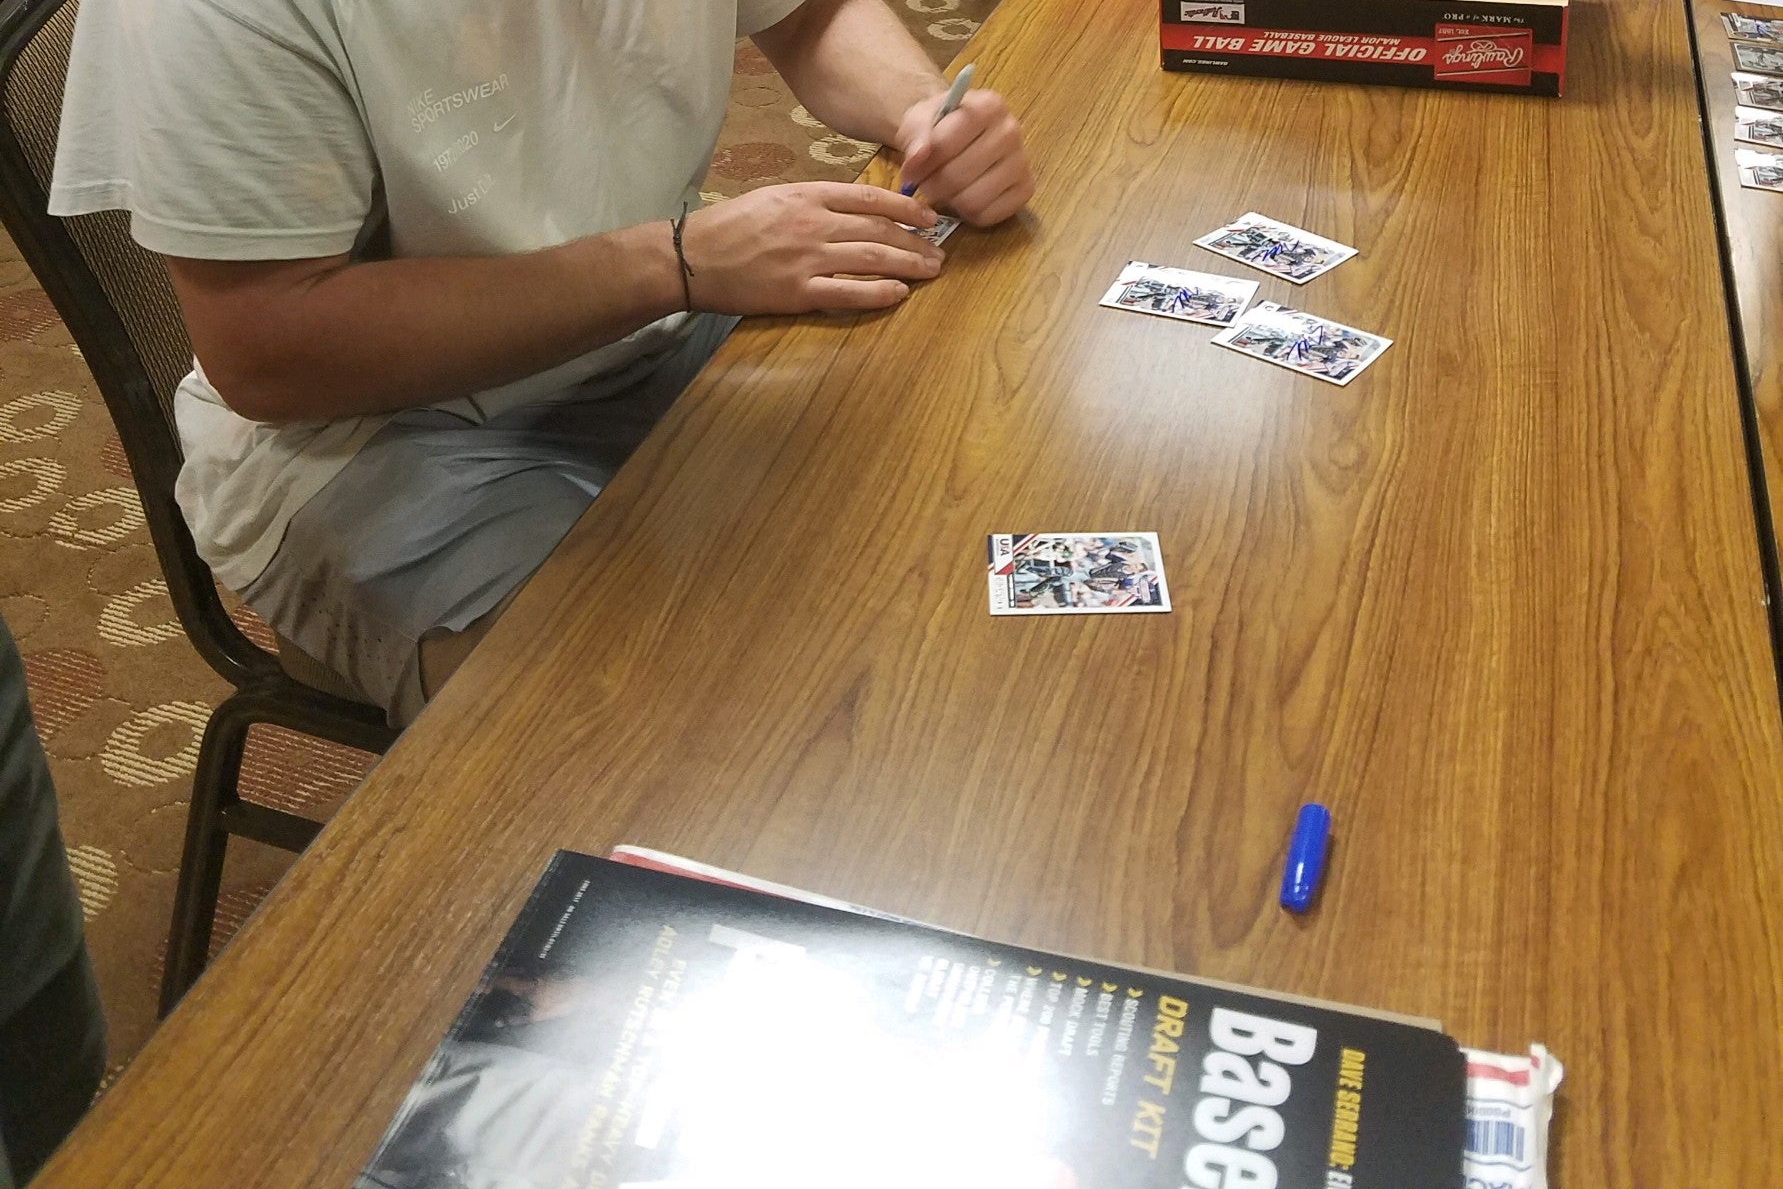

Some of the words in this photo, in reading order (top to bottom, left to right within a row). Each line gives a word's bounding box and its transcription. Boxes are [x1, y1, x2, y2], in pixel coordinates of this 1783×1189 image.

[1443, 12, 1466, 20] PRO
[1482, 15, 1512, 24] MARK
[1192, 35, 1246, 51] BALL
[1248, 38, 1317, 55] GAME
[1263, 31, 1316, 41] BASEBALL
[1317, 34, 1359, 43] LEAGUE
[1361, 37, 1402, 45] MAJOR
[1325, 43, 1428, 62] OFFICIAL
[1442, 43, 1524, 69] Rawlings
[411, 73, 509, 133] SPORTSWEAR
[448, 187, 480, 214] Just
[1068, 987, 1090, 1019] MOCK
[1096, 993, 1114, 1021] BEST
[1058, 1019, 1079, 1057] DRAFT
[1086, 1021, 1107, 1057] TOOLS
[1114, 998, 1139, 1053] SCOUTING
[1143, 995, 1189, 1096] DRAFT
[1101, 1054, 1126, 1106] REPORTS
[1338, 1048, 1366, 1090] DAVE
[1182, 1006, 1317, 1189] Base
[1130, 1099, 1167, 1160] KIT
